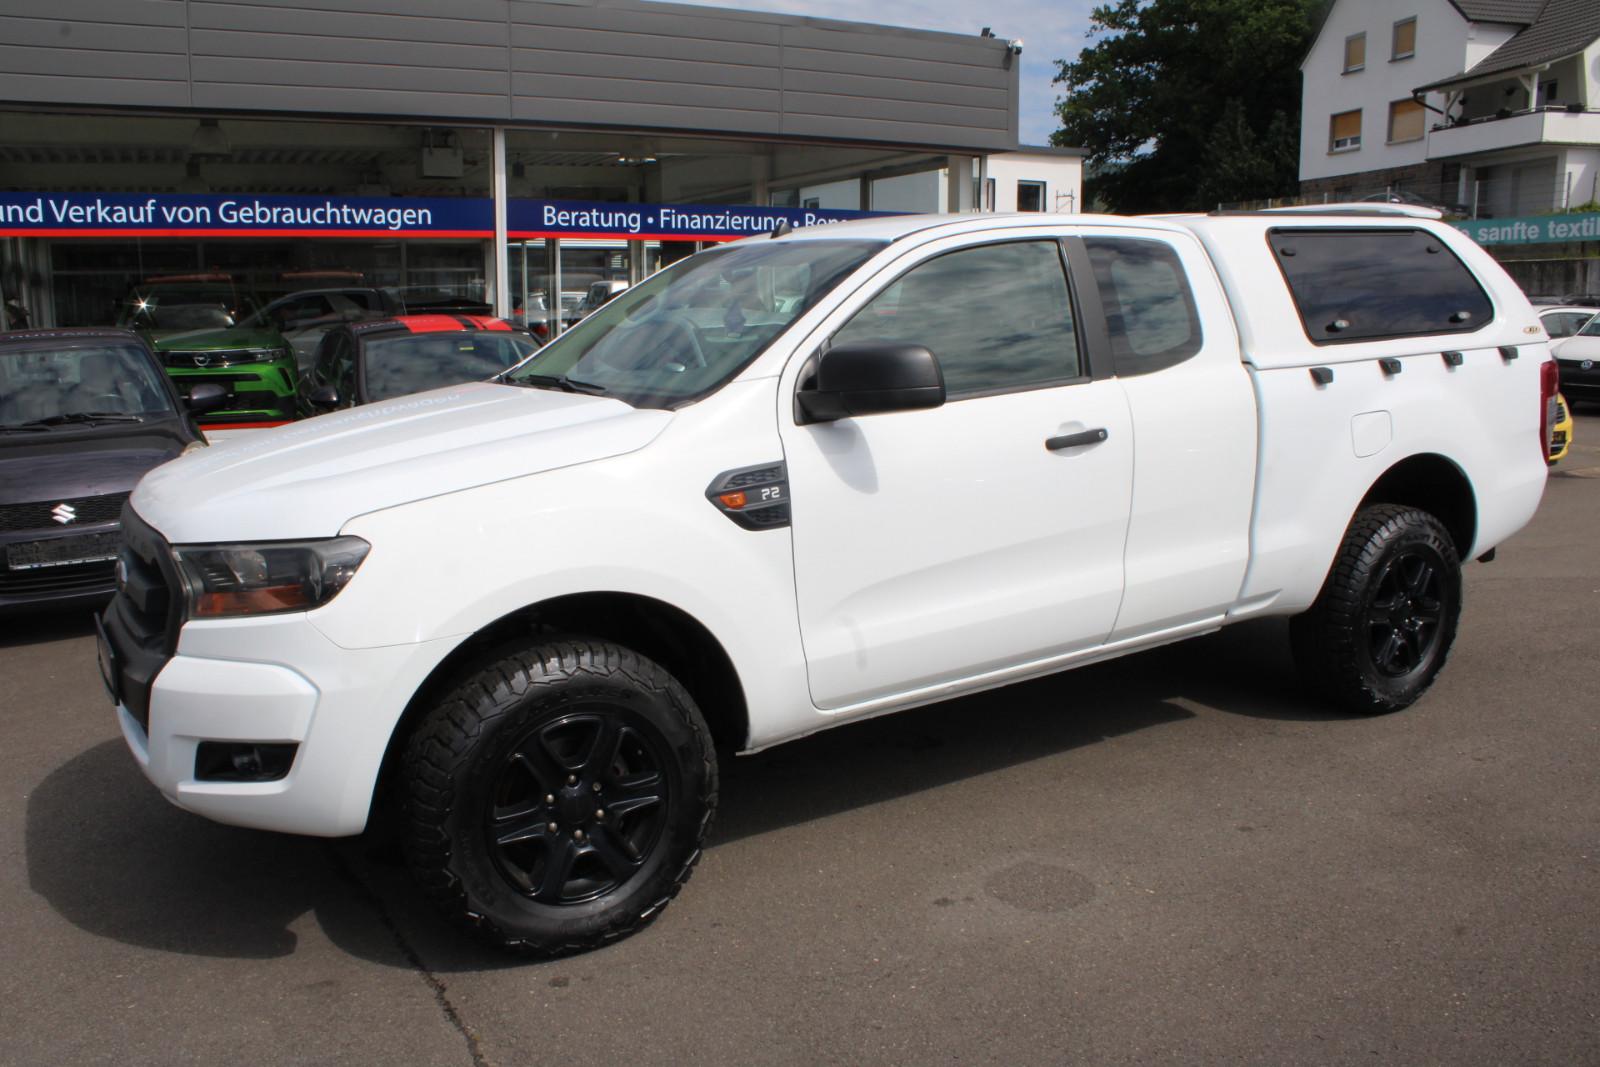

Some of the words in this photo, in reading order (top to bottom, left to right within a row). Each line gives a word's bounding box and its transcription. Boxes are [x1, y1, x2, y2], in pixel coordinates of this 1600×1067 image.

[0, 198, 44, 223] nd
[48, 198, 157, 223] Verkauf
[161, 206, 211, 224] von
[218, 201, 432, 230] Gebrauchtwagen
[543, 205, 641, 233] Beratung
[1477, 222, 1540, 242] sanfte
